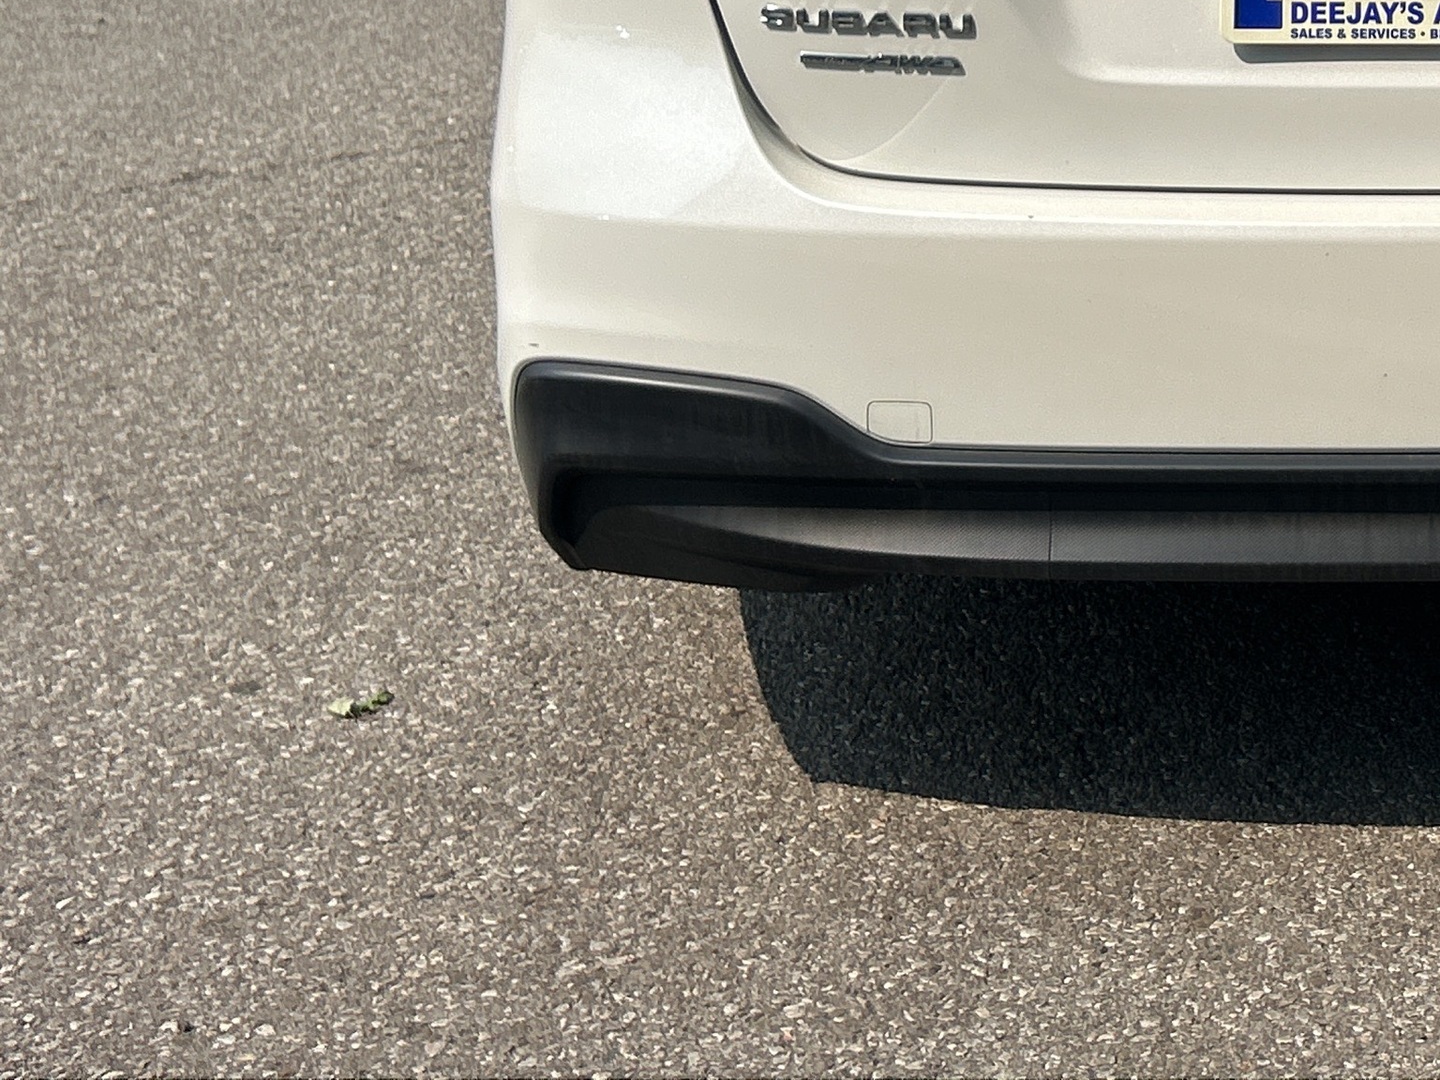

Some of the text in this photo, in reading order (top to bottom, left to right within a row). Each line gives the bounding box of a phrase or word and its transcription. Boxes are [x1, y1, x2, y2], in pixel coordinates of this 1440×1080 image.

[761, 5, 977, 39] SUBARU
[1290, 1, 1425, 25] DEEJAY'S
[1290, 28, 1333, 39] SALES
[1337, 28, 1347, 39] &
[1351, 28, 1416, 39] SERVICES
